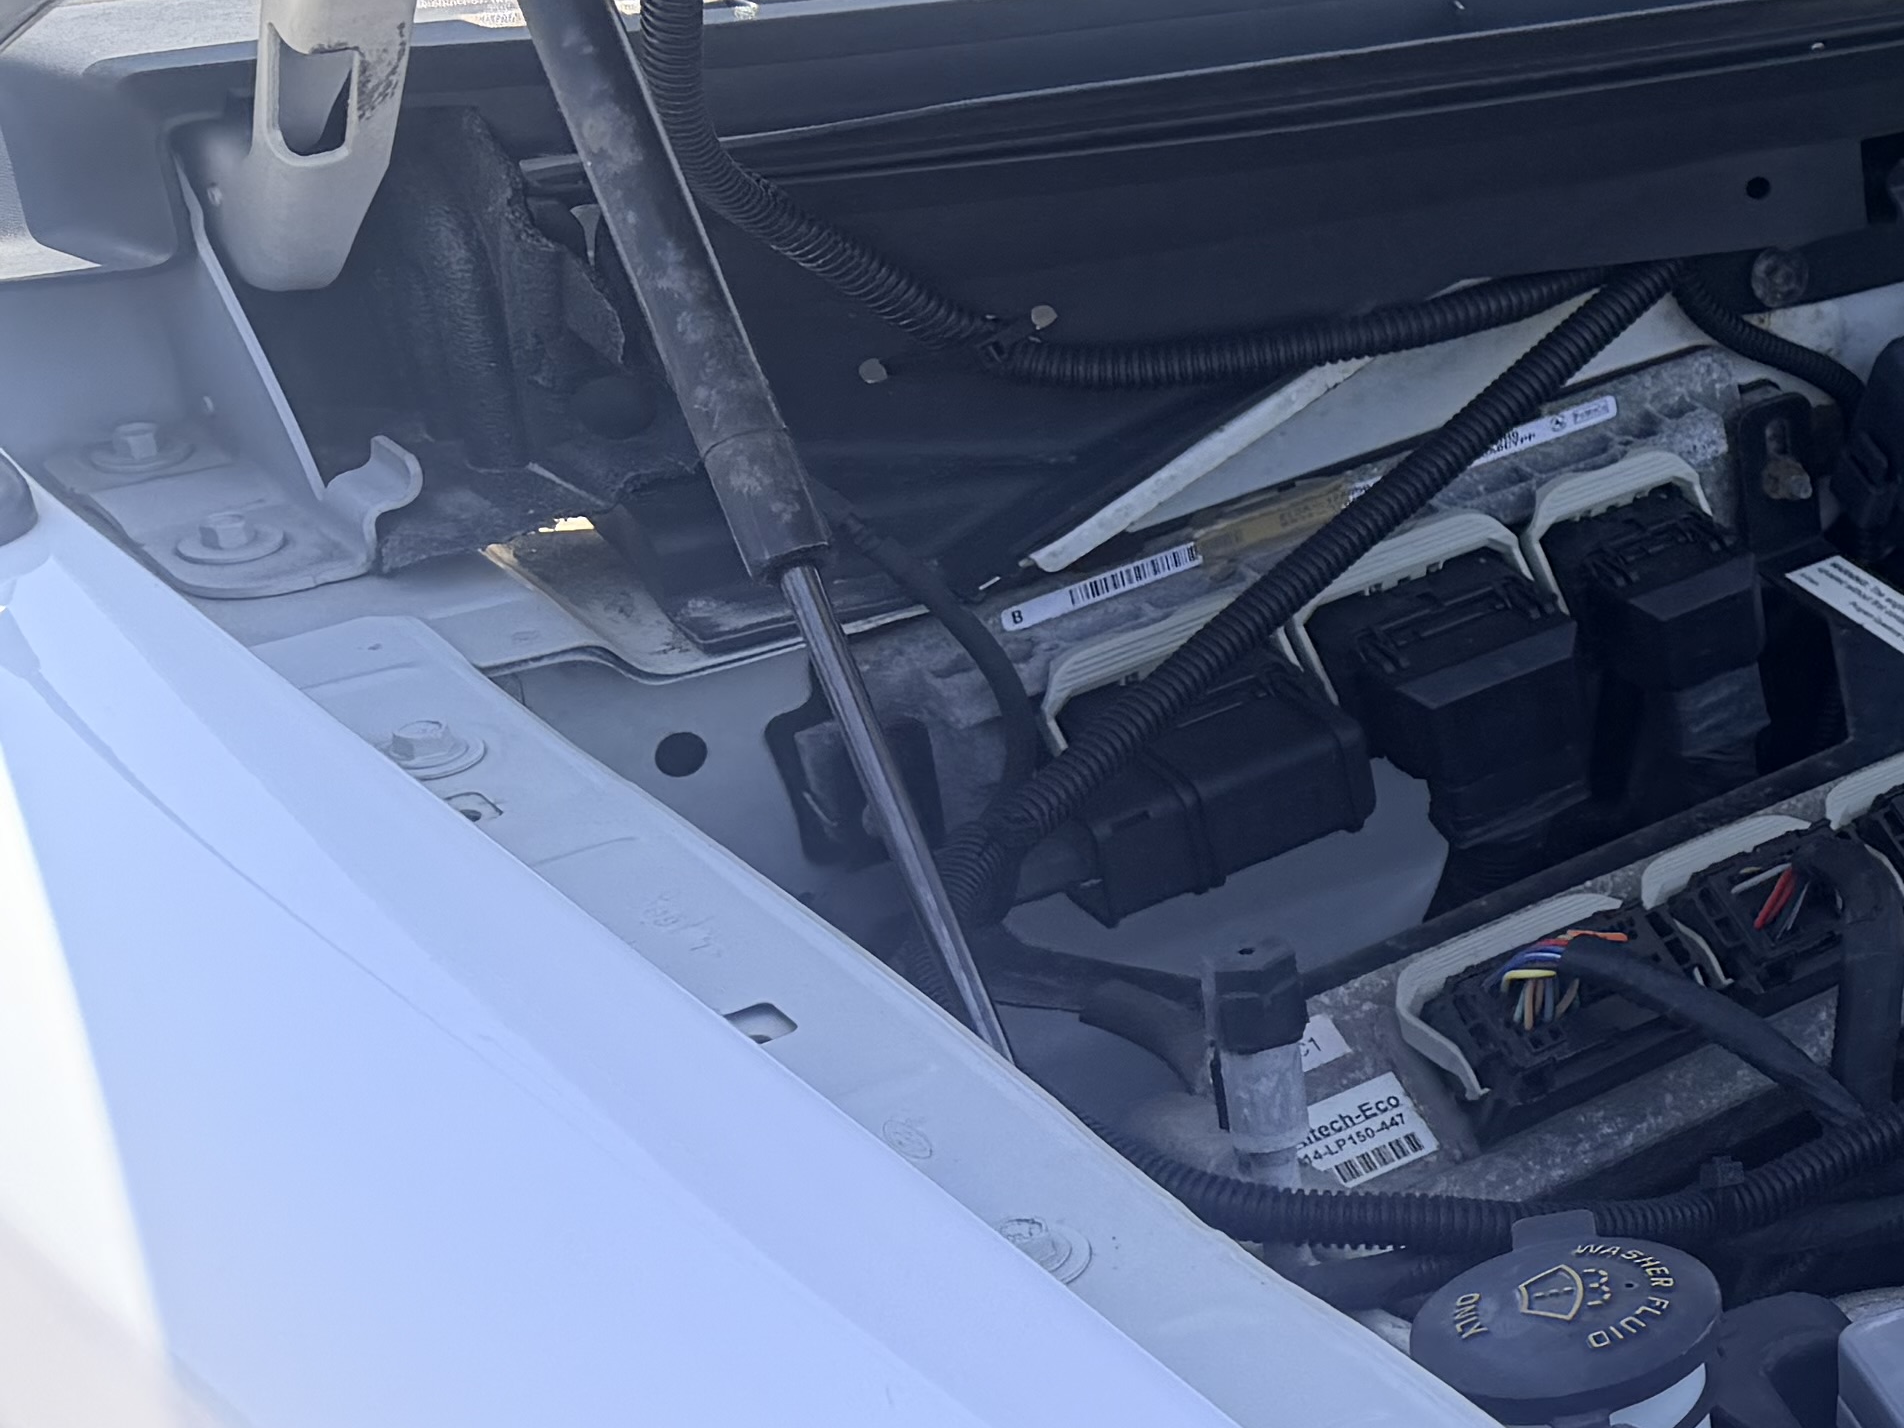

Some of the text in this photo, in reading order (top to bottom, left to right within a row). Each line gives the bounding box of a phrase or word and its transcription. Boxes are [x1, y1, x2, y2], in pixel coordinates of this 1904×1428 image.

[1011, 609, 1023, 625] B
[1453, 1243, 1675, 1348] WASHER FLUID ONLY
